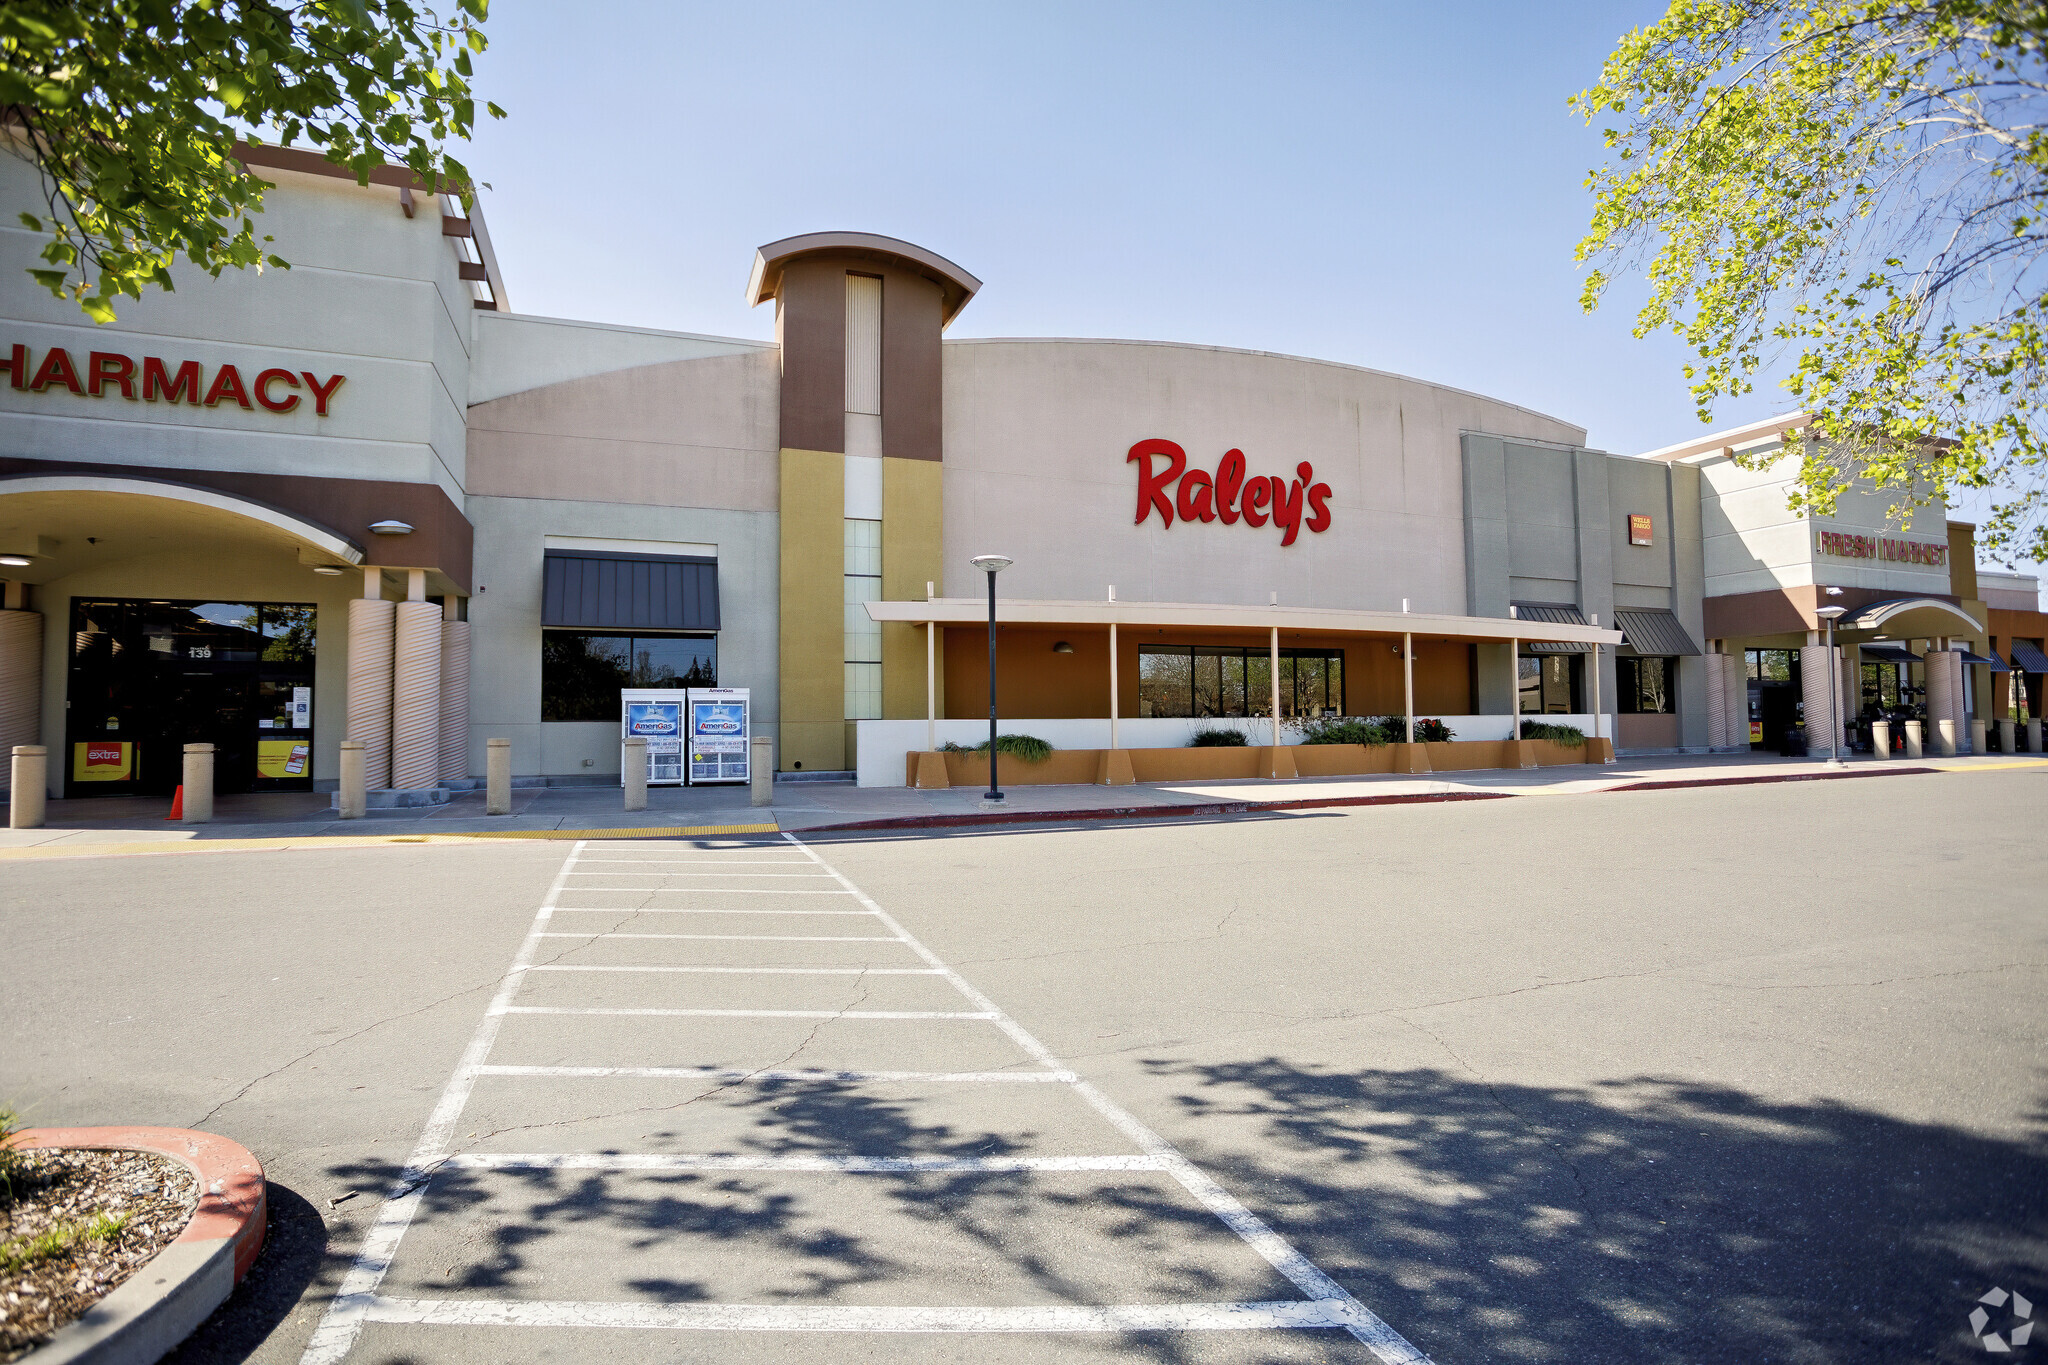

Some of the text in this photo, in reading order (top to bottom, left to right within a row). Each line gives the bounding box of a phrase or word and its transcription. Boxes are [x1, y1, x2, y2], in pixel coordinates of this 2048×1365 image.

[1126, 438, 1333, 547] Raley's
[1816, 531, 1948, 566] FRESH MARKET
[188, 650, 211, 658] 139
[88, 750, 120, 759] extra
